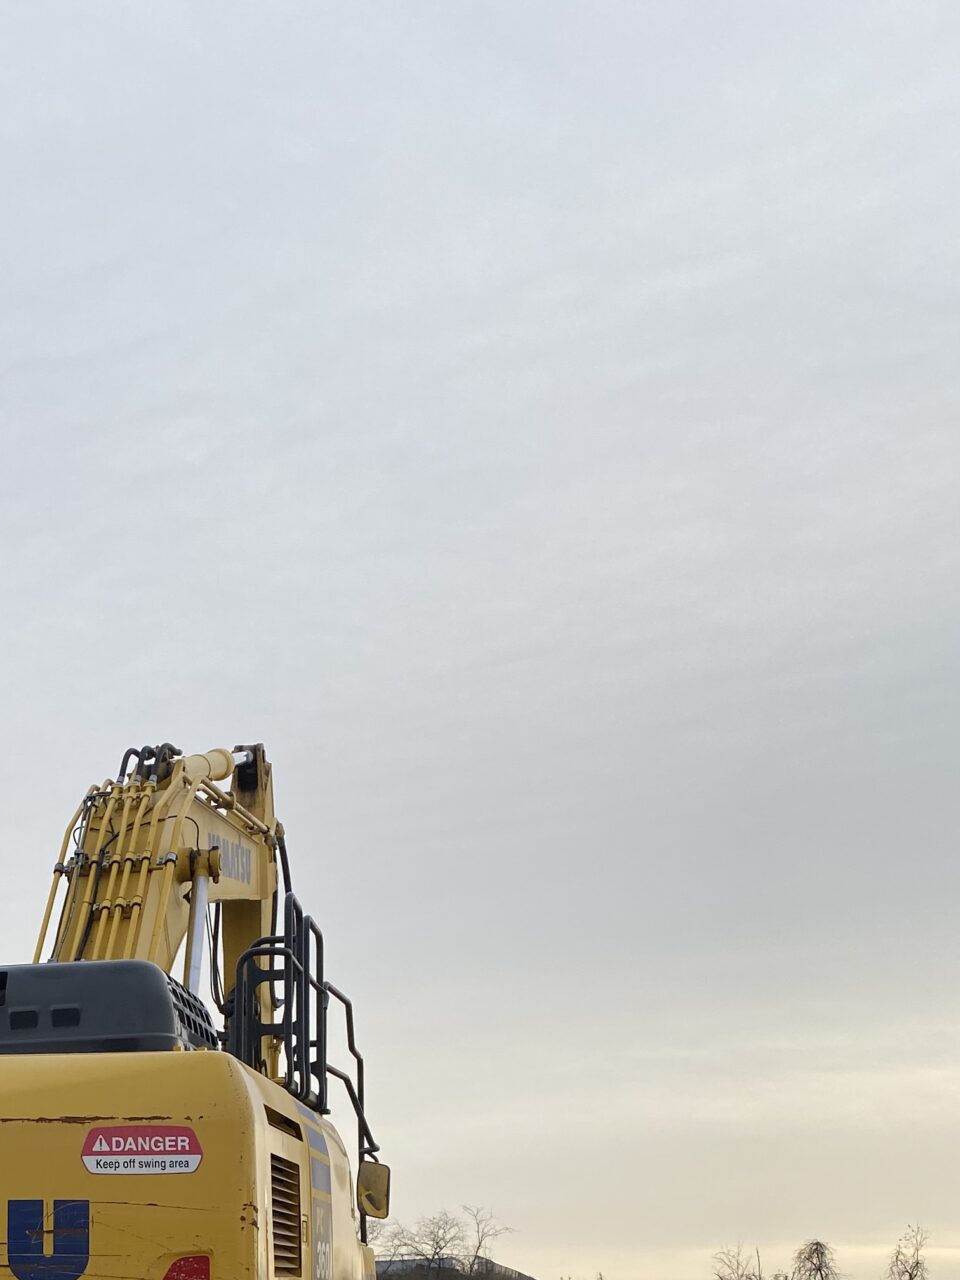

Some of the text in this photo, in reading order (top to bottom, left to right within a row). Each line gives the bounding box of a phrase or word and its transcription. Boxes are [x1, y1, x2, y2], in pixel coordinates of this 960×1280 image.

[112, 1136, 190, 1152] DANGER
[96, 1159, 189, 1171] Keep off swing area
[316, 1241, 330, 1280] 360
